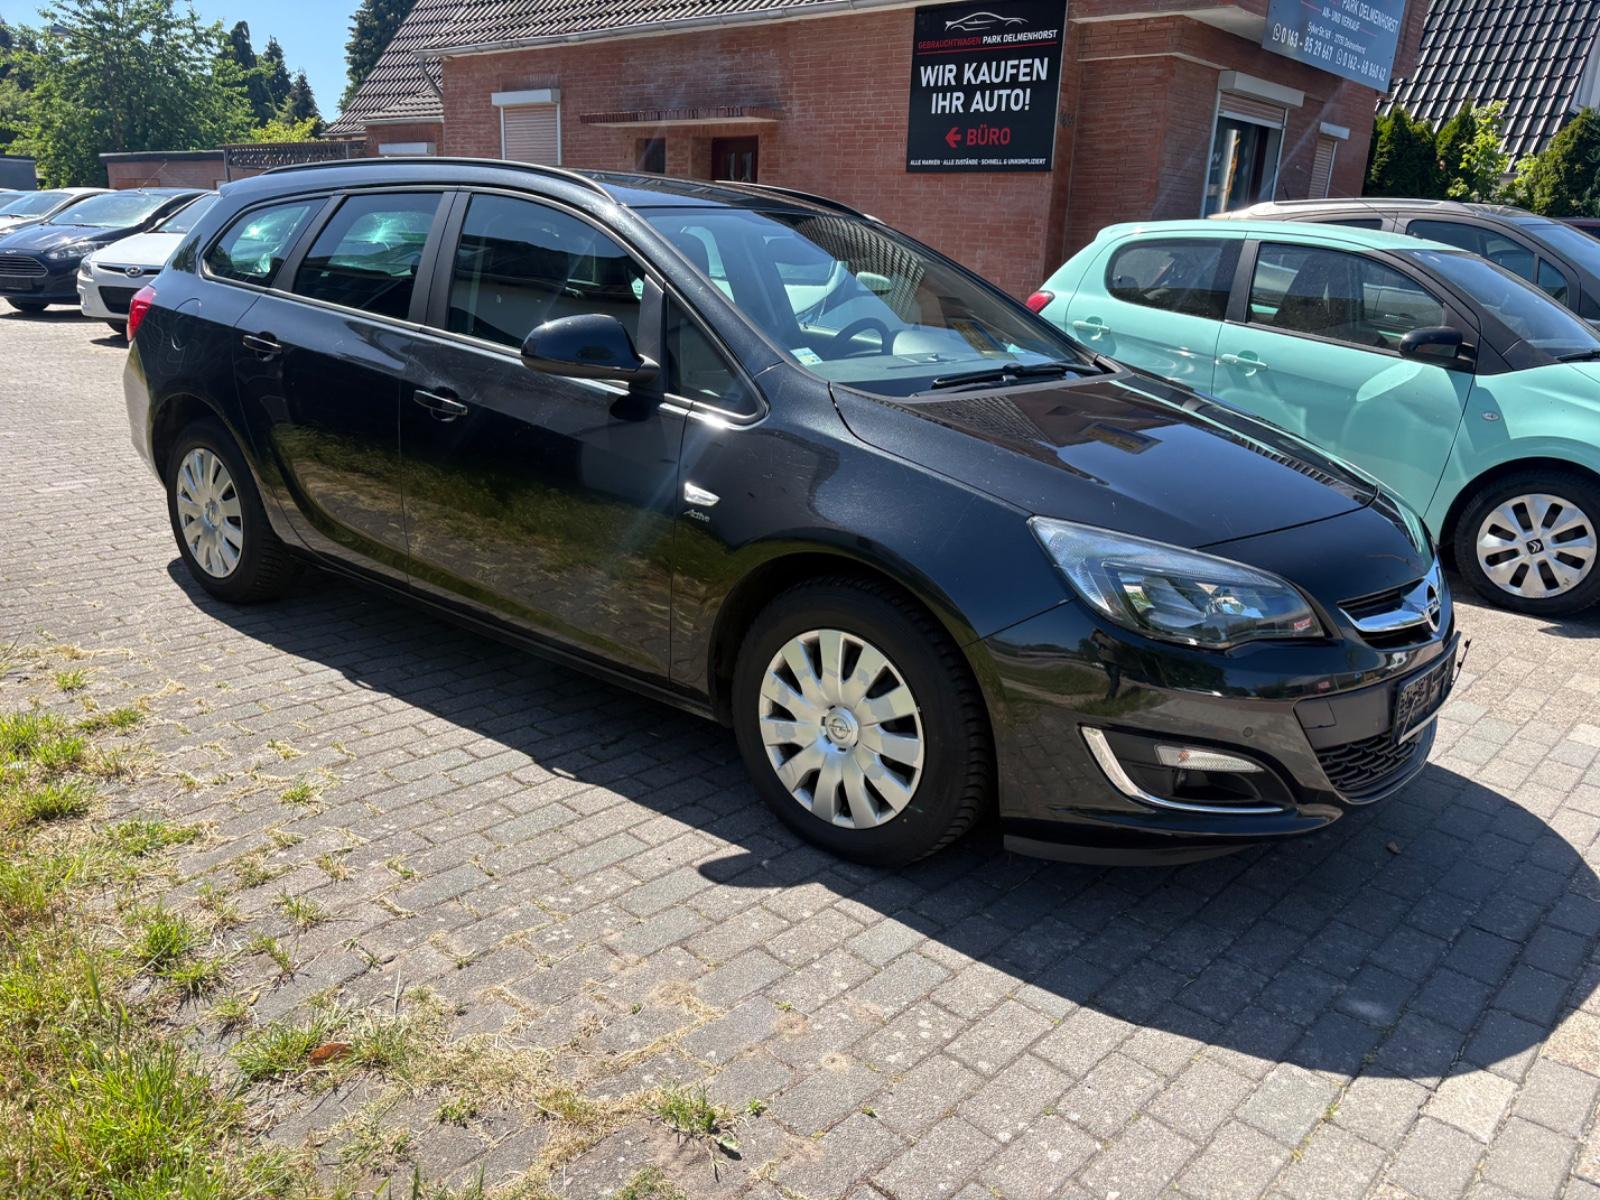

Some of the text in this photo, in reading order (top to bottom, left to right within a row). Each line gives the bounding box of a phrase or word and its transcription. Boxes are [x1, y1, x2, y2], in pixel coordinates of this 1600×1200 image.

[1341, 0, 1399, 34] PARK DELMENHORST
[918, 29, 1058, 49] GEBRAUCHTWAGEN PARK DELMENHORST
[920, 57, 1049, 88] WIR KAUFEN
[931, 88, 1031, 114] IHR AUTO!
[966, 123, 1011, 146] BÜRO
